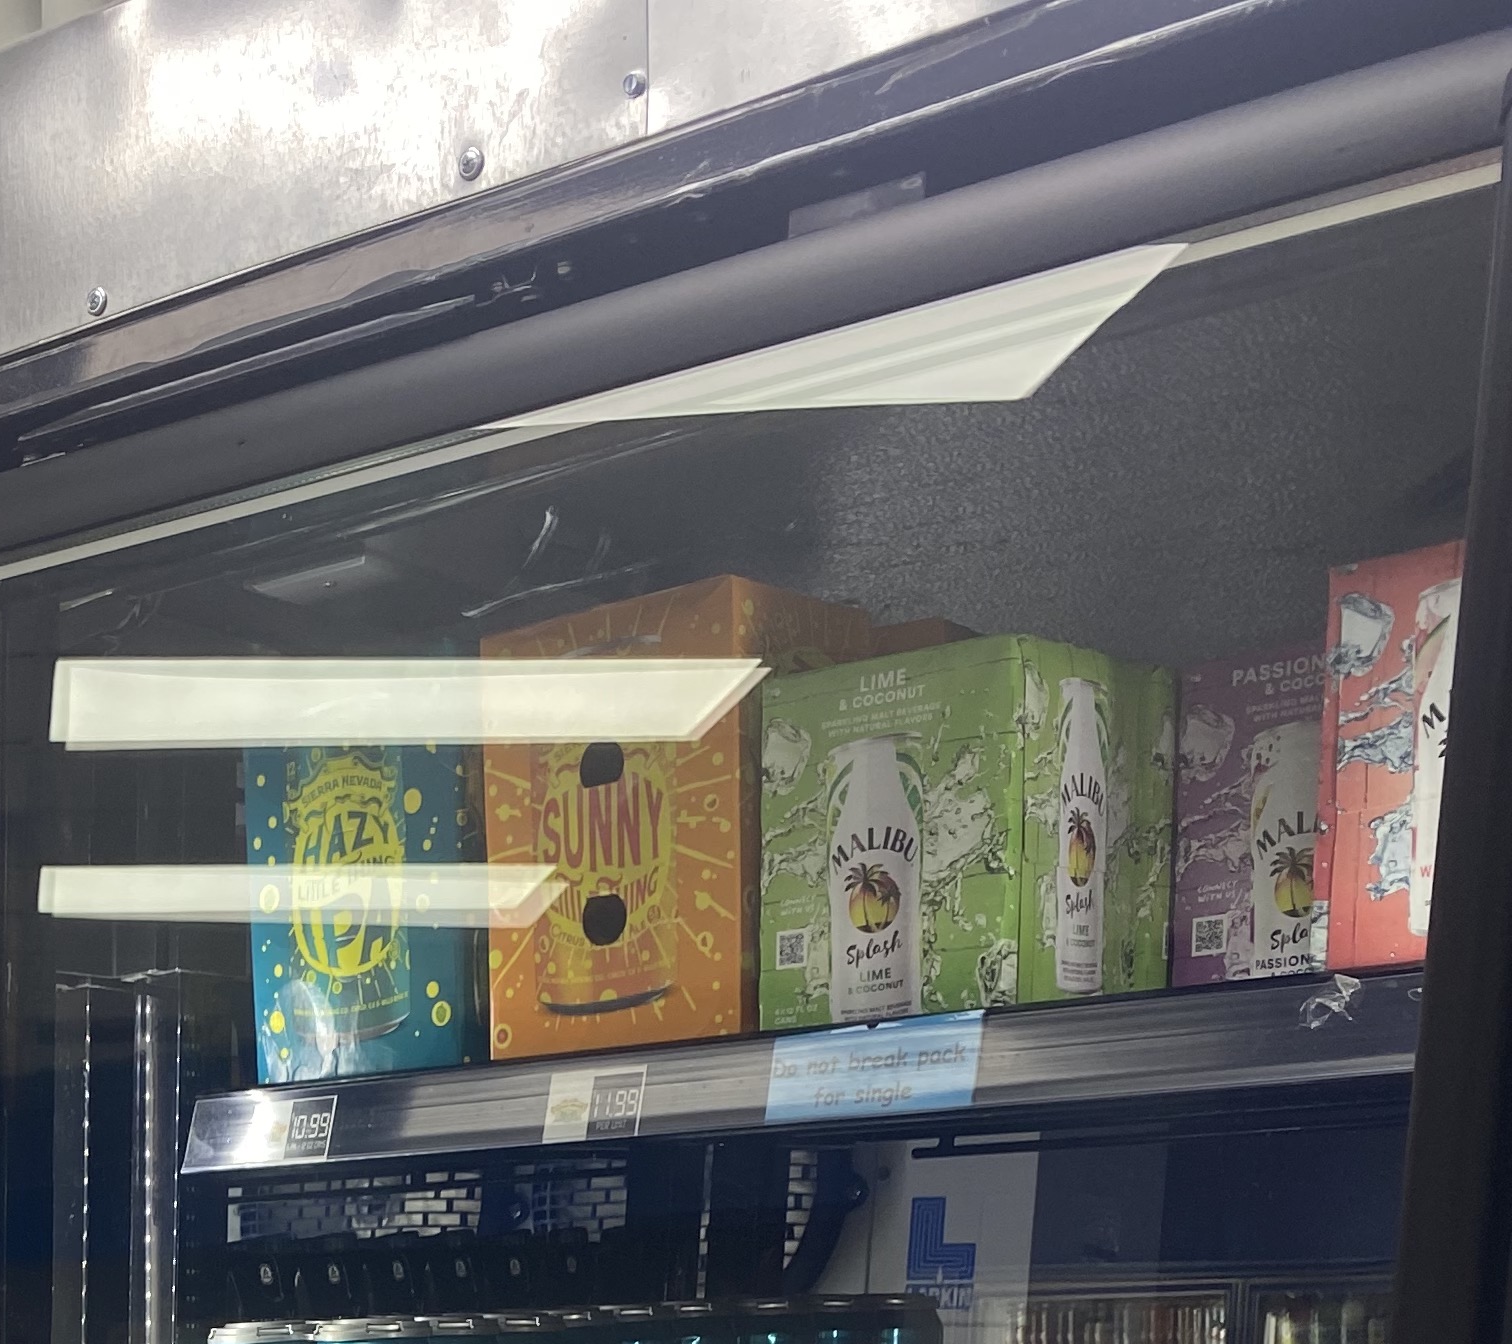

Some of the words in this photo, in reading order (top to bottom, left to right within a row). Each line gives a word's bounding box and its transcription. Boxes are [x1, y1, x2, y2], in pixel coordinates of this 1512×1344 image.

[859, 668, 907, 693] LIME
[852, 684, 926, 709] COCONUT
[340, 774, 383, 795] NEVADA
[542, 771, 664, 870] SUNNY
[831, 826, 918, 869] MALIBU
[846, 931, 903, 968] Splash
[859, 967, 892, 983] LIME
[807, 1053, 838, 1075] not
[848, 1047, 908, 1072] break
[917, 1043, 967, 1072] pack
[814, 1086, 844, 1108] for
[854, 1081, 913, 1110] single
